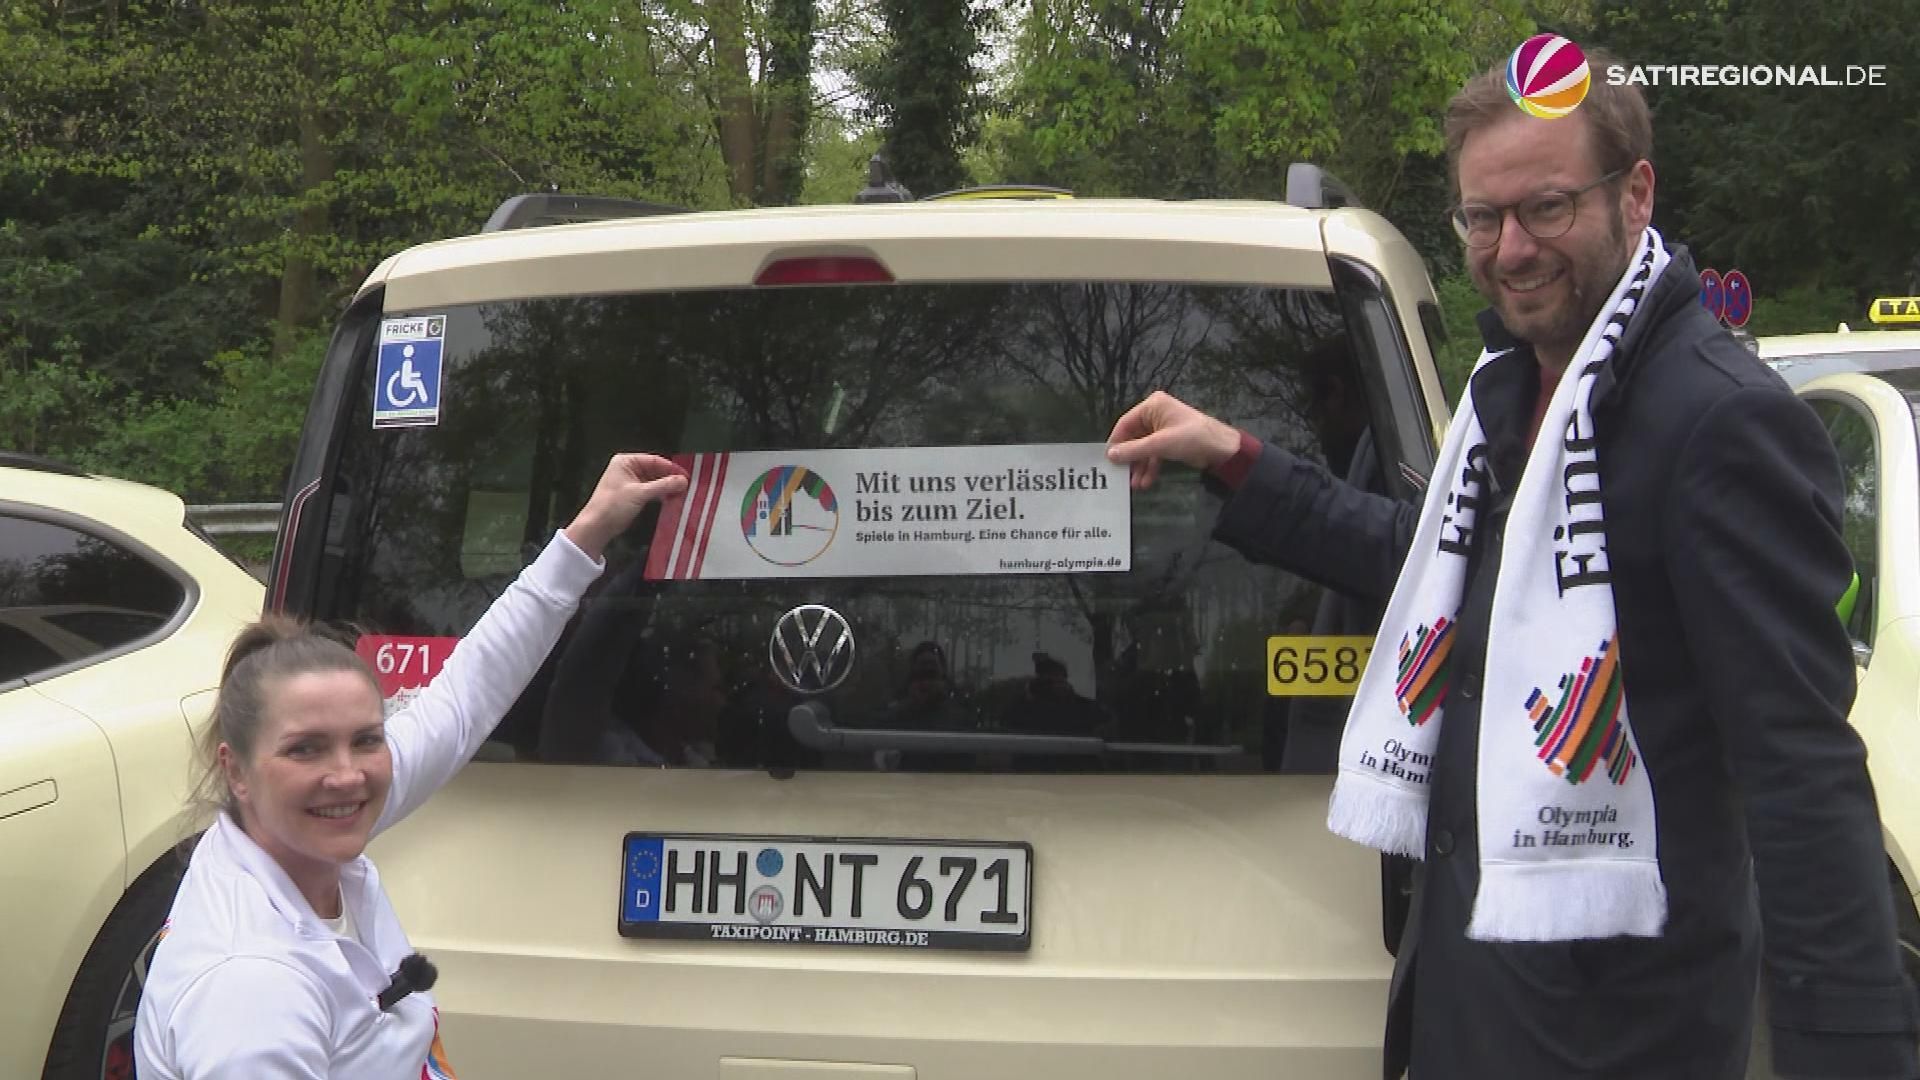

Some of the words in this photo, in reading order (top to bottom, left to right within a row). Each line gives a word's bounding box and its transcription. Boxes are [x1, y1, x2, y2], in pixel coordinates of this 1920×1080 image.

[386, 322, 424, 335] FRICKE
[856, 471, 900, 493] Mit
[909, 475, 956, 493] uns
[963, 467, 1108, 491] verlässlich
[856, 500, 893, 522] bis
[901, 504, 958, 522] zum
[966, 497, 1025, 520] Ziel.
[855, 531, 895, 543] Spiele
[898, 530, 911, 541] in
[913, 530, 976, 543] Hamburg.
[979, 530, 1007, 540] Eine
[1010, 528, 1058, 539] Chance
[1061, 526, 1081, 539] für
[1084, 527, 1112, 539] alle.
[999, 557, 1122, 570] hamburg-olympia.de
[376, 643, 430, 675] 671
[1359, 750, 1377, 768] in
[1538, 804, 1618, 827] Olympia
[1513, 830, 1536, 848] in
[1543, 828, 1635, 849] Hamburg.
[665, 850, 748, 914] HH
[793, 853, 878, 918] NT
[896, 856, 1019, 924] 671
[636, 890, 650, 908] D
[711, 925, 802, 941] TAXIPOINT
[815, 928, 929, 946] HAMBURG.DE
